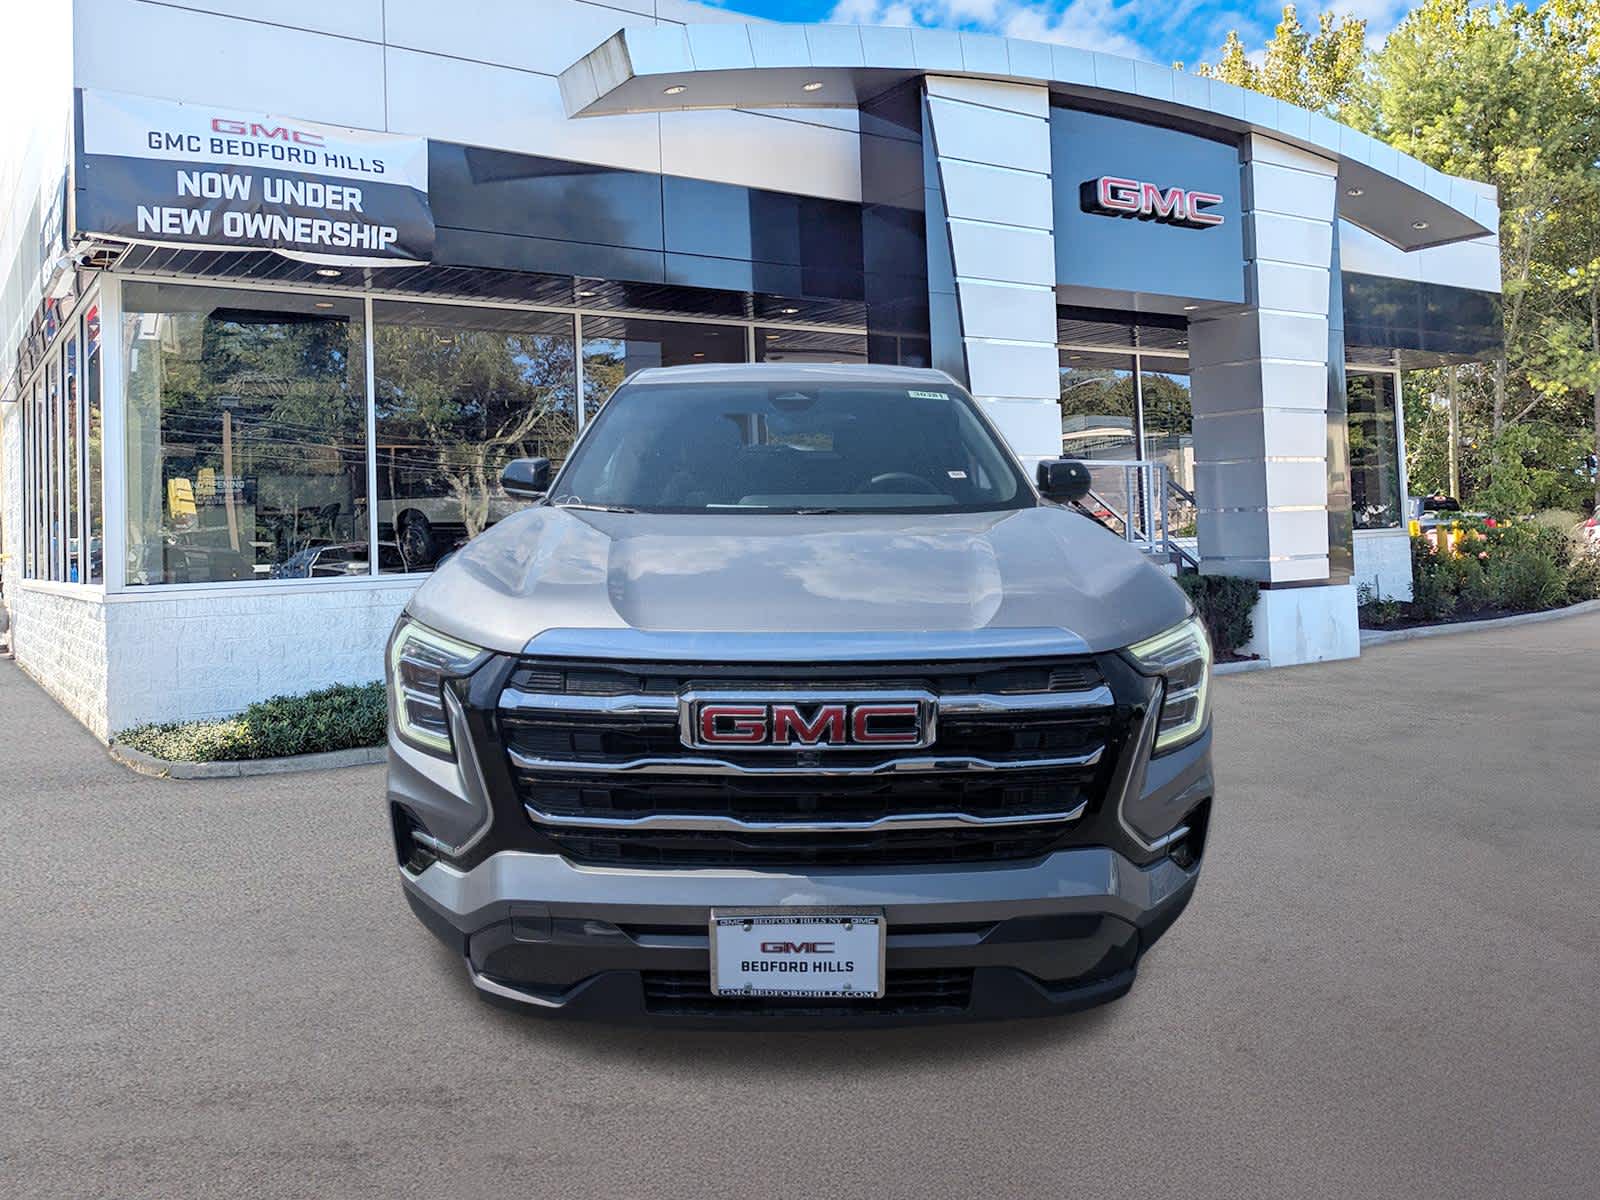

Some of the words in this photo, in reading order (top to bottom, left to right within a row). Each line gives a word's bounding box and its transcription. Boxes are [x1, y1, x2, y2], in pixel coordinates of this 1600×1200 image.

[148, 131, 201, 152] GMC
[210, 138, 317, 165] BEDFORD
[325, 153, 385, 174] HILLS
[211, 118, 326, 147] GMC
[176, 170, 252, 201] NOW
[263, 176, 364, 213] UNDER
[1098, 176, 1225, 224] GMC
[136, 205, 211, 236] NEW
[223, 211, 398, 250] OWNERSHIP
[700, 704, 919, 744] GMC
[753, 918, 798, 926] BEDFORD
[800, 918, 826, 926] HILLS
[741, 961, 808, 972] BEDFORD
[812, 961, 854, 972] HILLS
[761, 942, 835, 953] GMC
